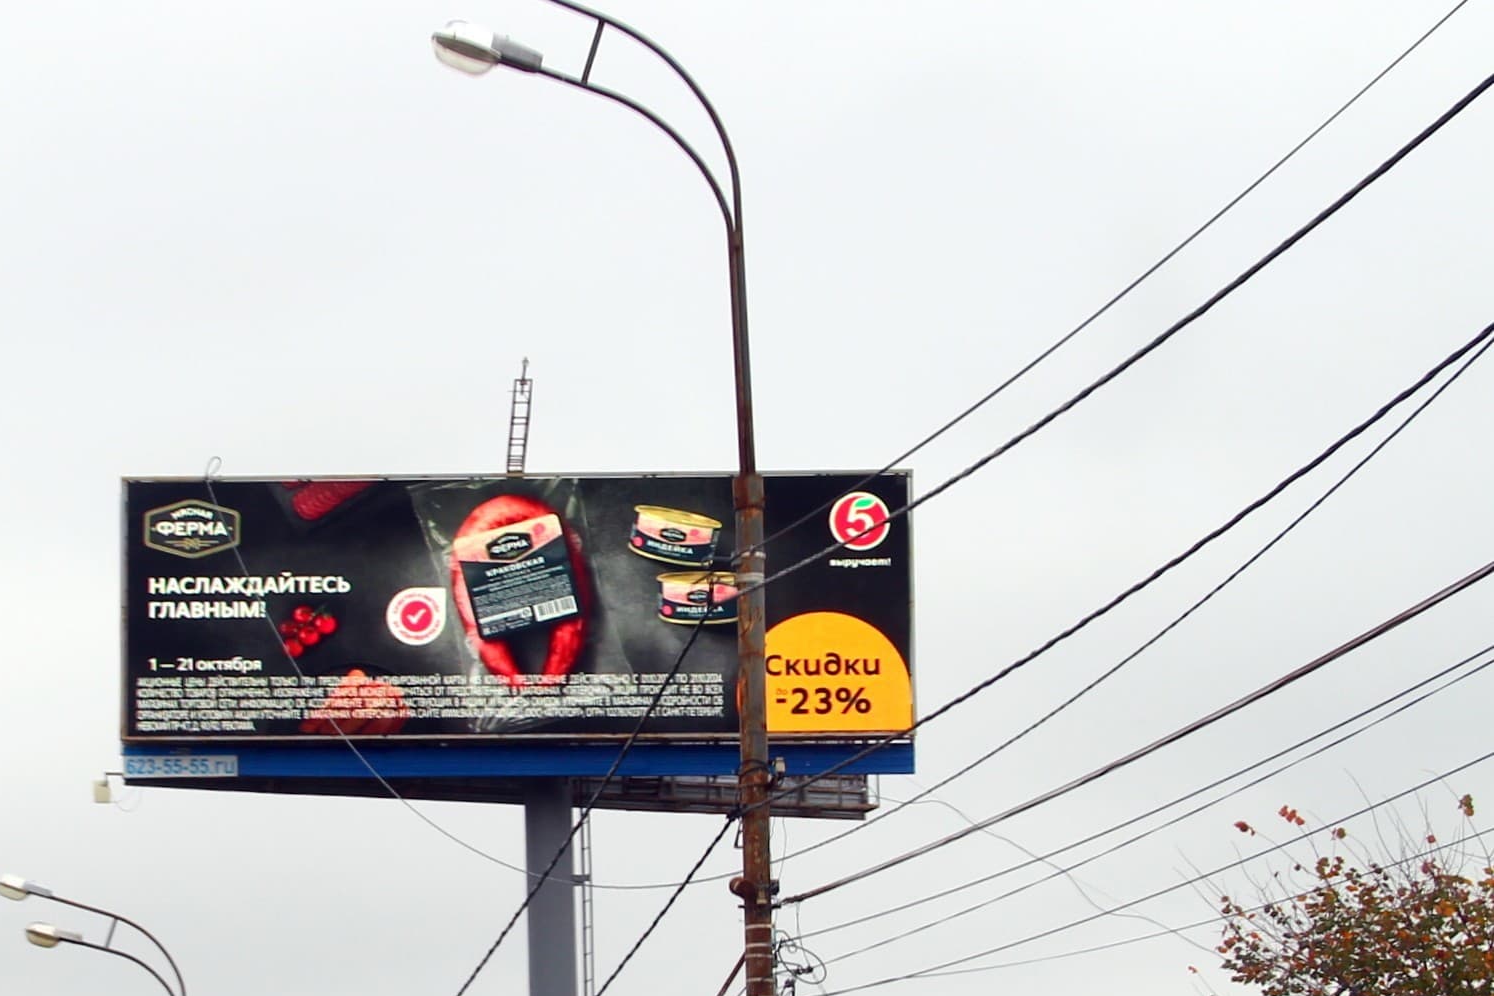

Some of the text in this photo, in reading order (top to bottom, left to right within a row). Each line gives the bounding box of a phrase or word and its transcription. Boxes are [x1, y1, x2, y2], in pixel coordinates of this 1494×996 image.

[156, 521, 229, 537] ФЕРМА
[829, 557, 892, 568] выручает!
[147, 572, 352, 597] НАСЛАЖДАЙТЕСЬ
[147, 601, 267, 619] ГЛАВНЫМ!
[148, 657, 158, 671] 1
[176, 657, 194, 671] 21
[195, 656, 263, 674] октября
[765, 652, 881, 677] Скидки
[775, 687, 872, 715] -23%
[126, 758, 235, 775] 623-55-55.ru
